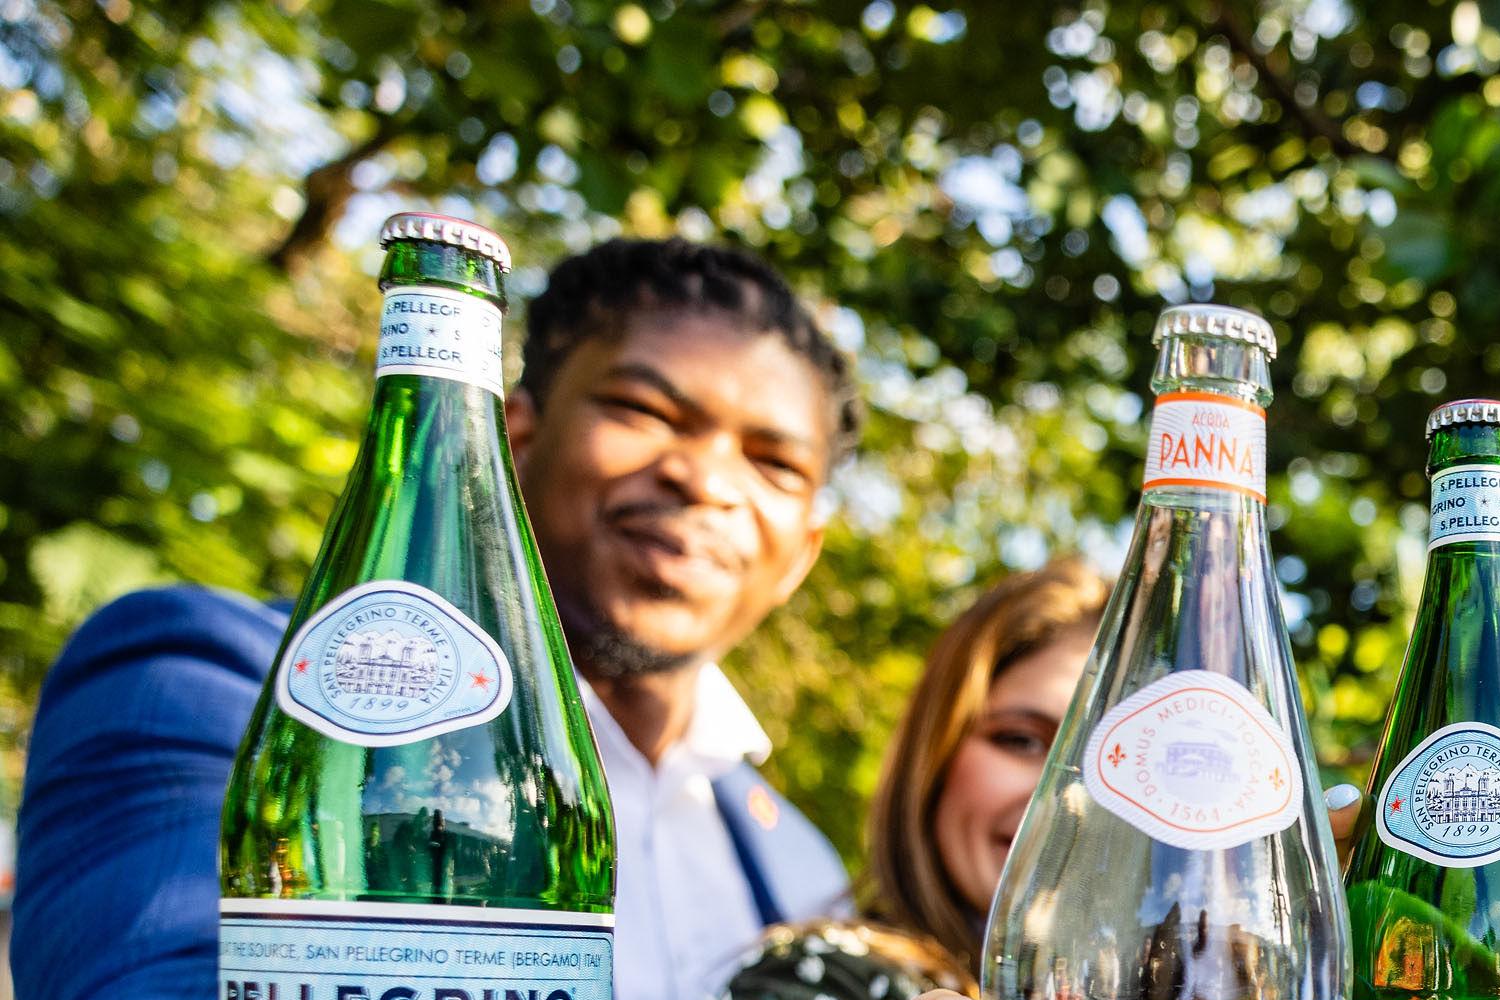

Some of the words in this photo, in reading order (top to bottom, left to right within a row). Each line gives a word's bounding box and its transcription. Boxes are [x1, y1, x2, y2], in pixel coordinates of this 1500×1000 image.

[1191, 410, 1230, 430] ACQUA
[1159, 432, 1255, 479] PANNA
[324, 607, 398, 666] PELLEGRINO
[404, 609, 446, 647] TERME
[323, 675, 343, 699] SAN
[420, 667, 454, 705] ITALIA
[349, 696, 410, 712] 1899
[1135, 726, 1157, 797] DOMUS
[1157, 696, 1228, 722] MEDICI
[1414, 745, 1470, 803] PELLEGRINO
[1416, 806, 1434, 831] SAN
[1442, 824, 1491, 838] 1899
[306, 944, 341, 960] SAN
[346, 945, 449, 965] PELLEGRINO
[456, 949, 506, 966] TERME
